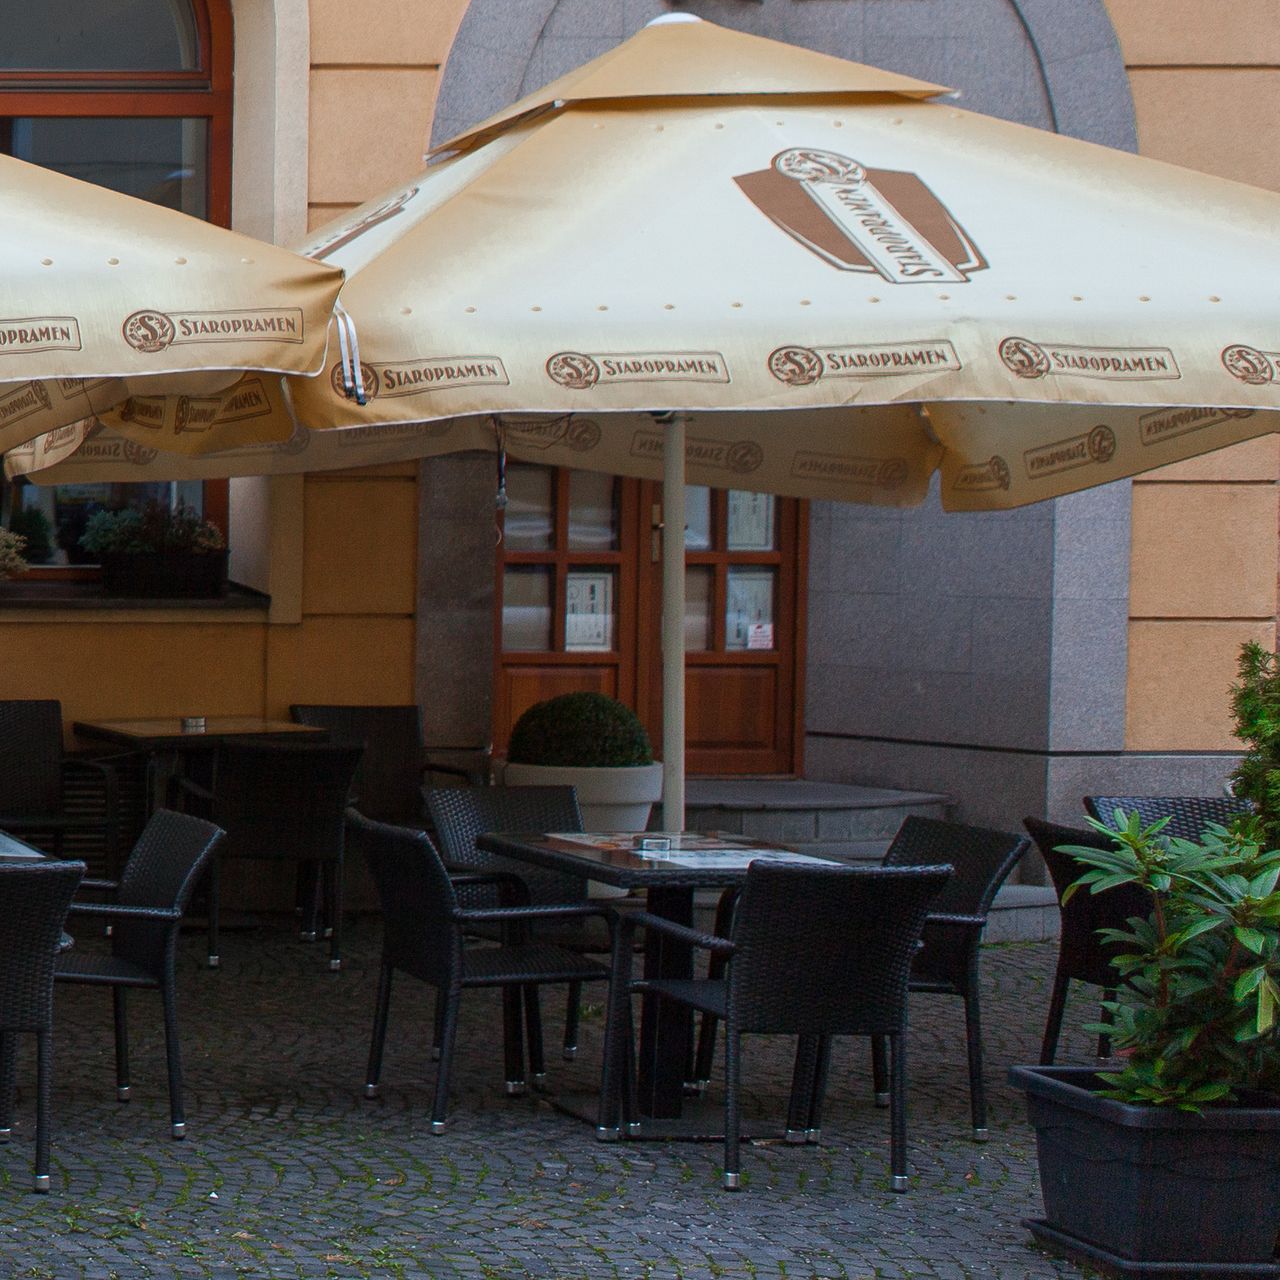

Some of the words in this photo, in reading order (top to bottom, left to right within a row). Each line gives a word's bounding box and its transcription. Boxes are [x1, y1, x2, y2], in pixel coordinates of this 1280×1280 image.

[179, 317, 296, 337] STAROPRAMEN
[602, 359, 719, 376] STAROPRAMEN
[826, 349, 949, 370] STAROPRAMEN
[1050, 350, 1169, 371] STAROPRAMEN
[382, 363, 499, 389] STAROPRAMEN
